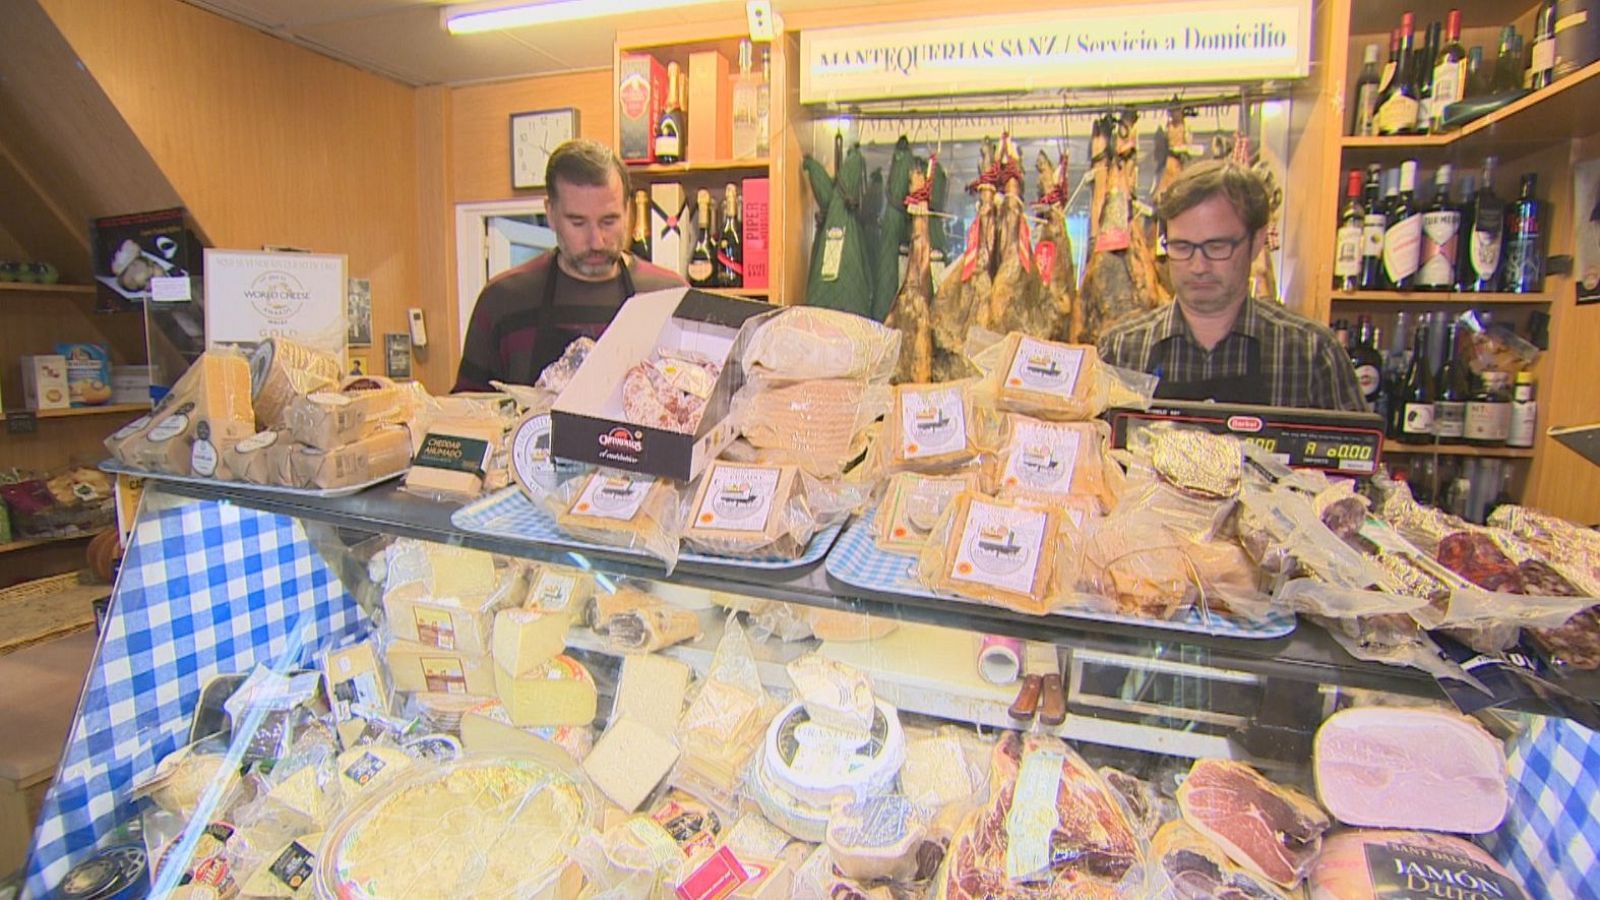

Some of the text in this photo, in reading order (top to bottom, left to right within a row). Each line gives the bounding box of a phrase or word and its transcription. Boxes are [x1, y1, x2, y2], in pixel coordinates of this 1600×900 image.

[820, 40, 994, 76] MANTEQUERIAS
[1000, 35, 1058, 58] SANZ
[1076, 29, 1158, 53] Servicio
[1184, 22, 1287, 50] Domicilio
[746, 202, 760, 240] PIPER
[259, 328, 298, 338] GOLD
[428, 438, 462, 450] CHEDDAR
[424, 447, 463, 460] AHUMADO
[1391, 841, 1428, 858] SANT
[1393, 857, 1504, 898] JAMÓN
